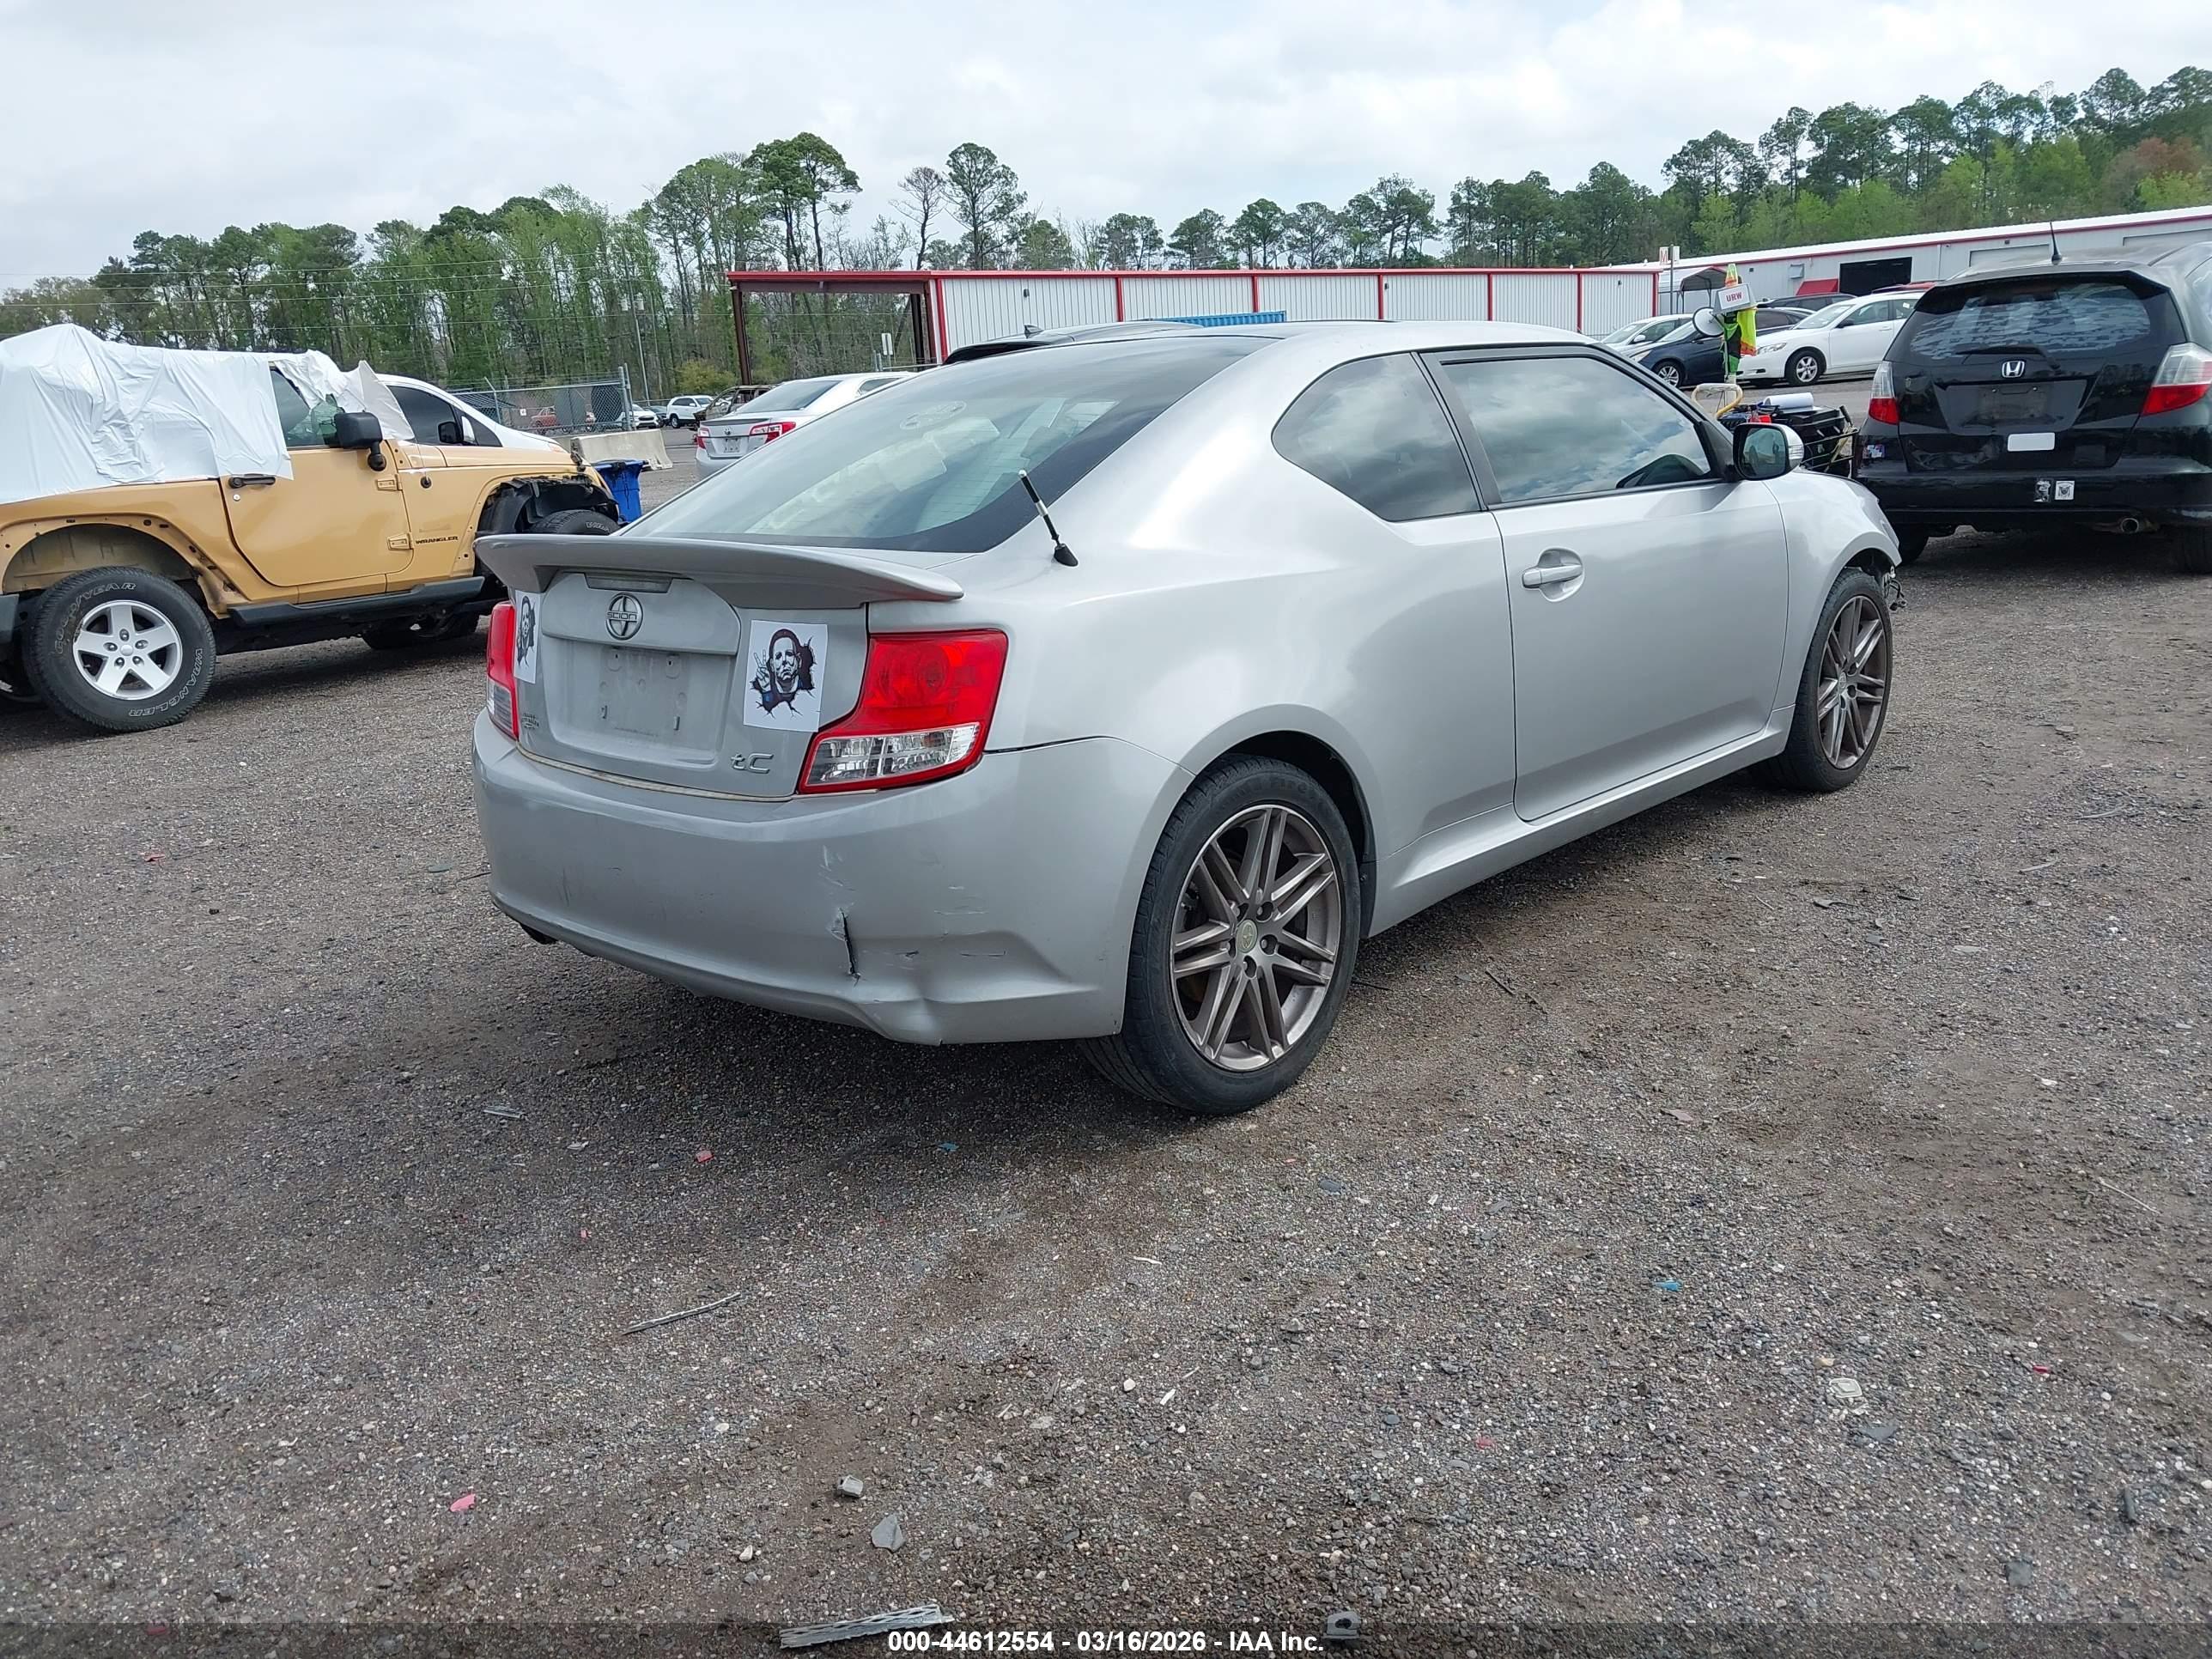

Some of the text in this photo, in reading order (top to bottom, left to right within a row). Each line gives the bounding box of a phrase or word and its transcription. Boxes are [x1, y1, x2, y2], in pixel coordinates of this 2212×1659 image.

[1726, 292, 1742, 302] URW
[416, 536, 459, 544] WRANGLER
[129, 648, 204, 717] WRANGLER
